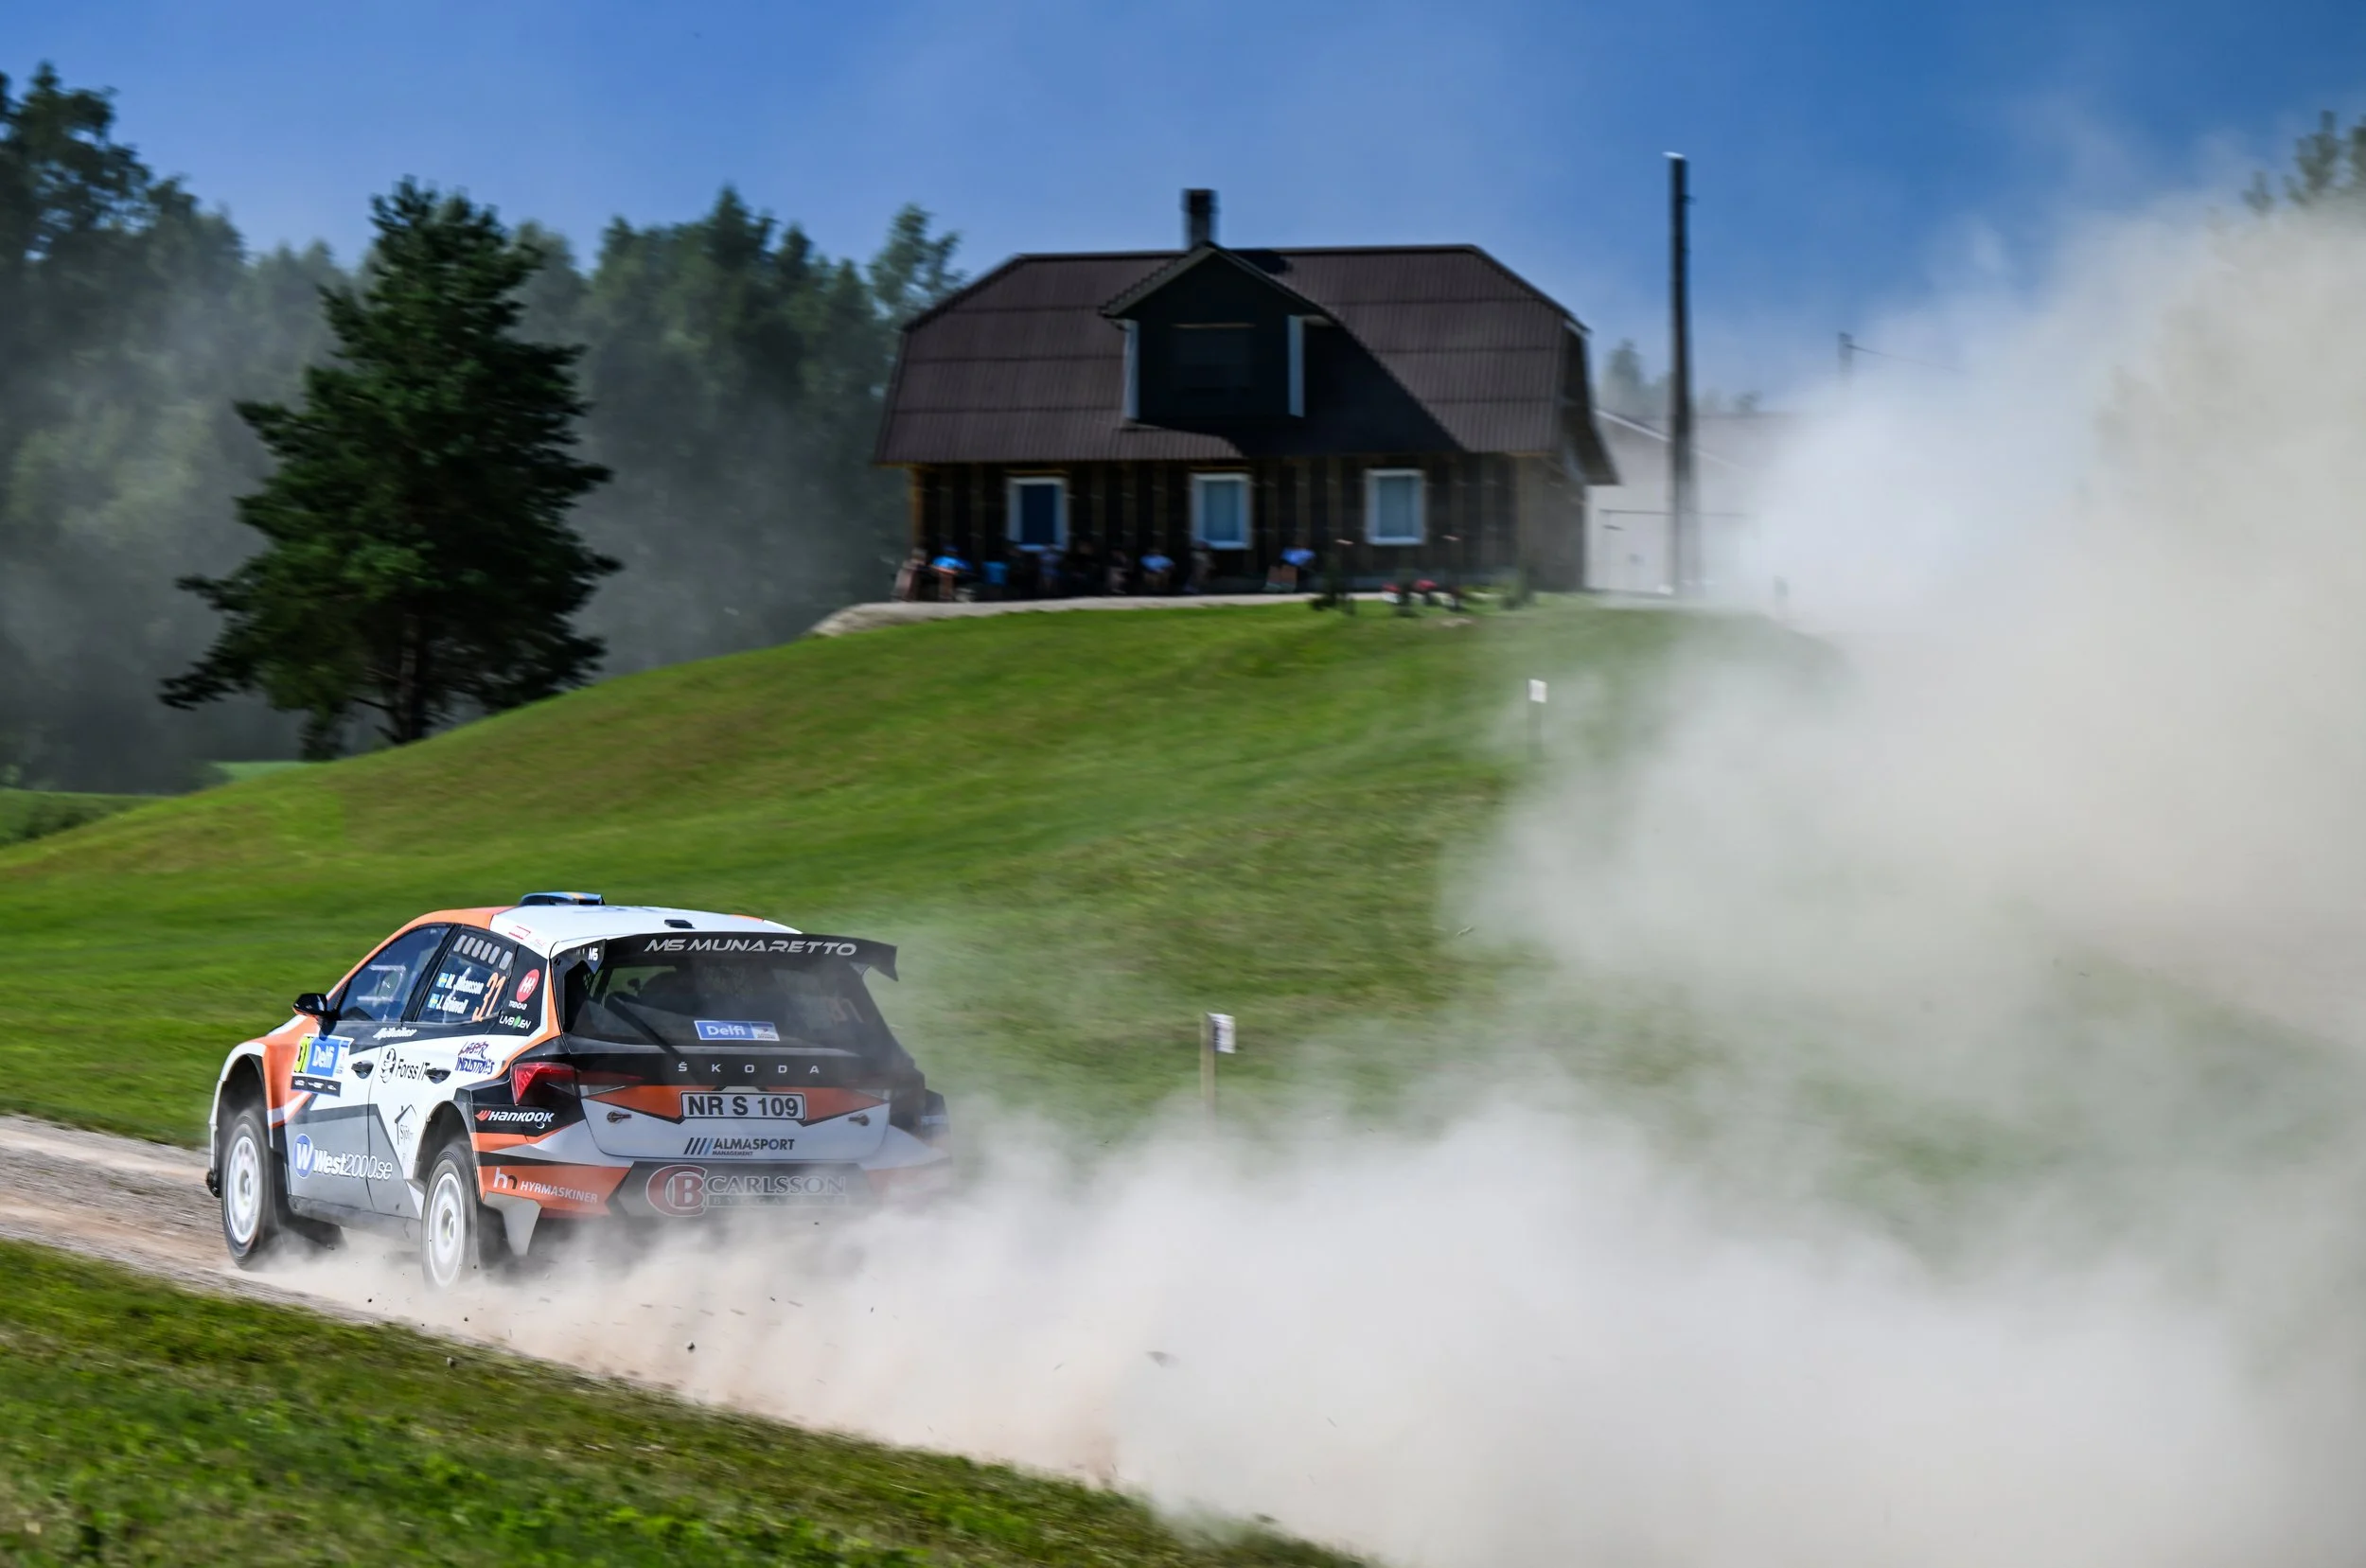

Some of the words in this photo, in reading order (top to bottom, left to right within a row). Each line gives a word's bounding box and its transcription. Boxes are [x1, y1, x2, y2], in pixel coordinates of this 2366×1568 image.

[644, 939, 686, 952] MS
[686, 939, 857, 957] MUNARETTO
[471, 972, 506, 1022] 31
[706, 1025, 746, 1036] Delfi
[311, 1046, 335, 1069] Delfi
[395, 1059, 417, 1080] Forss
[688, 1095, 725, 1116] NR
[733, 1096, 749, 1115] S
[758, 1097, 799, 1118] 109
[713, 1137, 795, 1151] ALMASPORT
[313, 1149, 393, 1180] West2000.se
[520, 1180, 598, 1204] HYRMASKINER
[706, 1175, 846, 1194] CARLSSON
